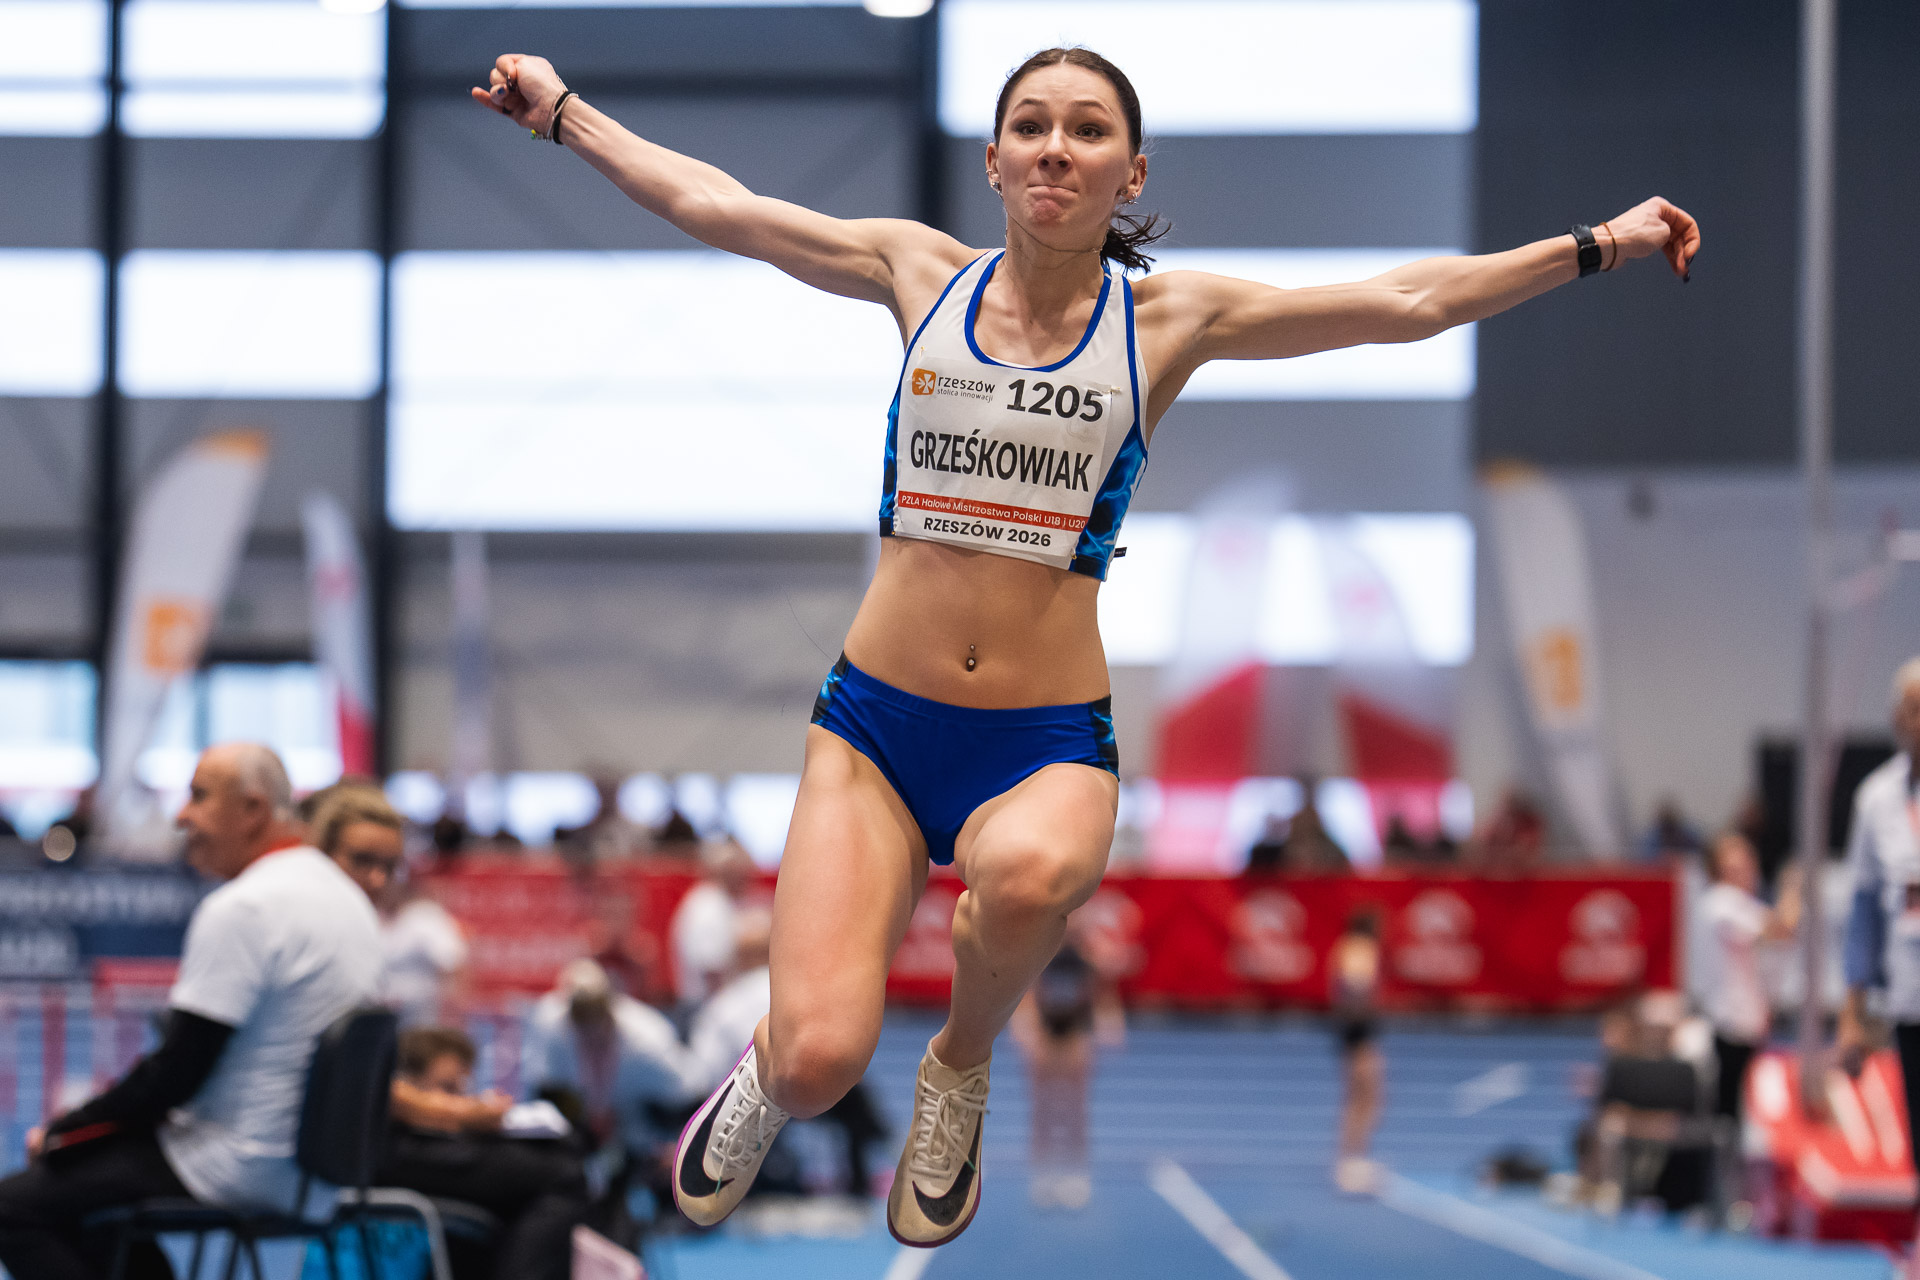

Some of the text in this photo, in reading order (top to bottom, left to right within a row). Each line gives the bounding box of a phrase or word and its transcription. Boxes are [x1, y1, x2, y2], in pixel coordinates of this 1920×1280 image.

[937, 388, 959, 397] stolica
[938, 376, 996, 394] rzeszów
[1006, 378, 1104, 422] 1205
[910, 428, 1094, 492] GRZEŚKOWIAK
[901, 495, 920, 506] PZLA
[921, 498, 951, 510] Halowe
[952, 502, 1011, 519] Mistrzostwa
[1013, 510, 1042, 523] Polski
[1043, 515, 1061, 526] U18
[1068, 519, 1085, 529] U20
[923, 516, 1051, 547] RZESZÓW 2026
